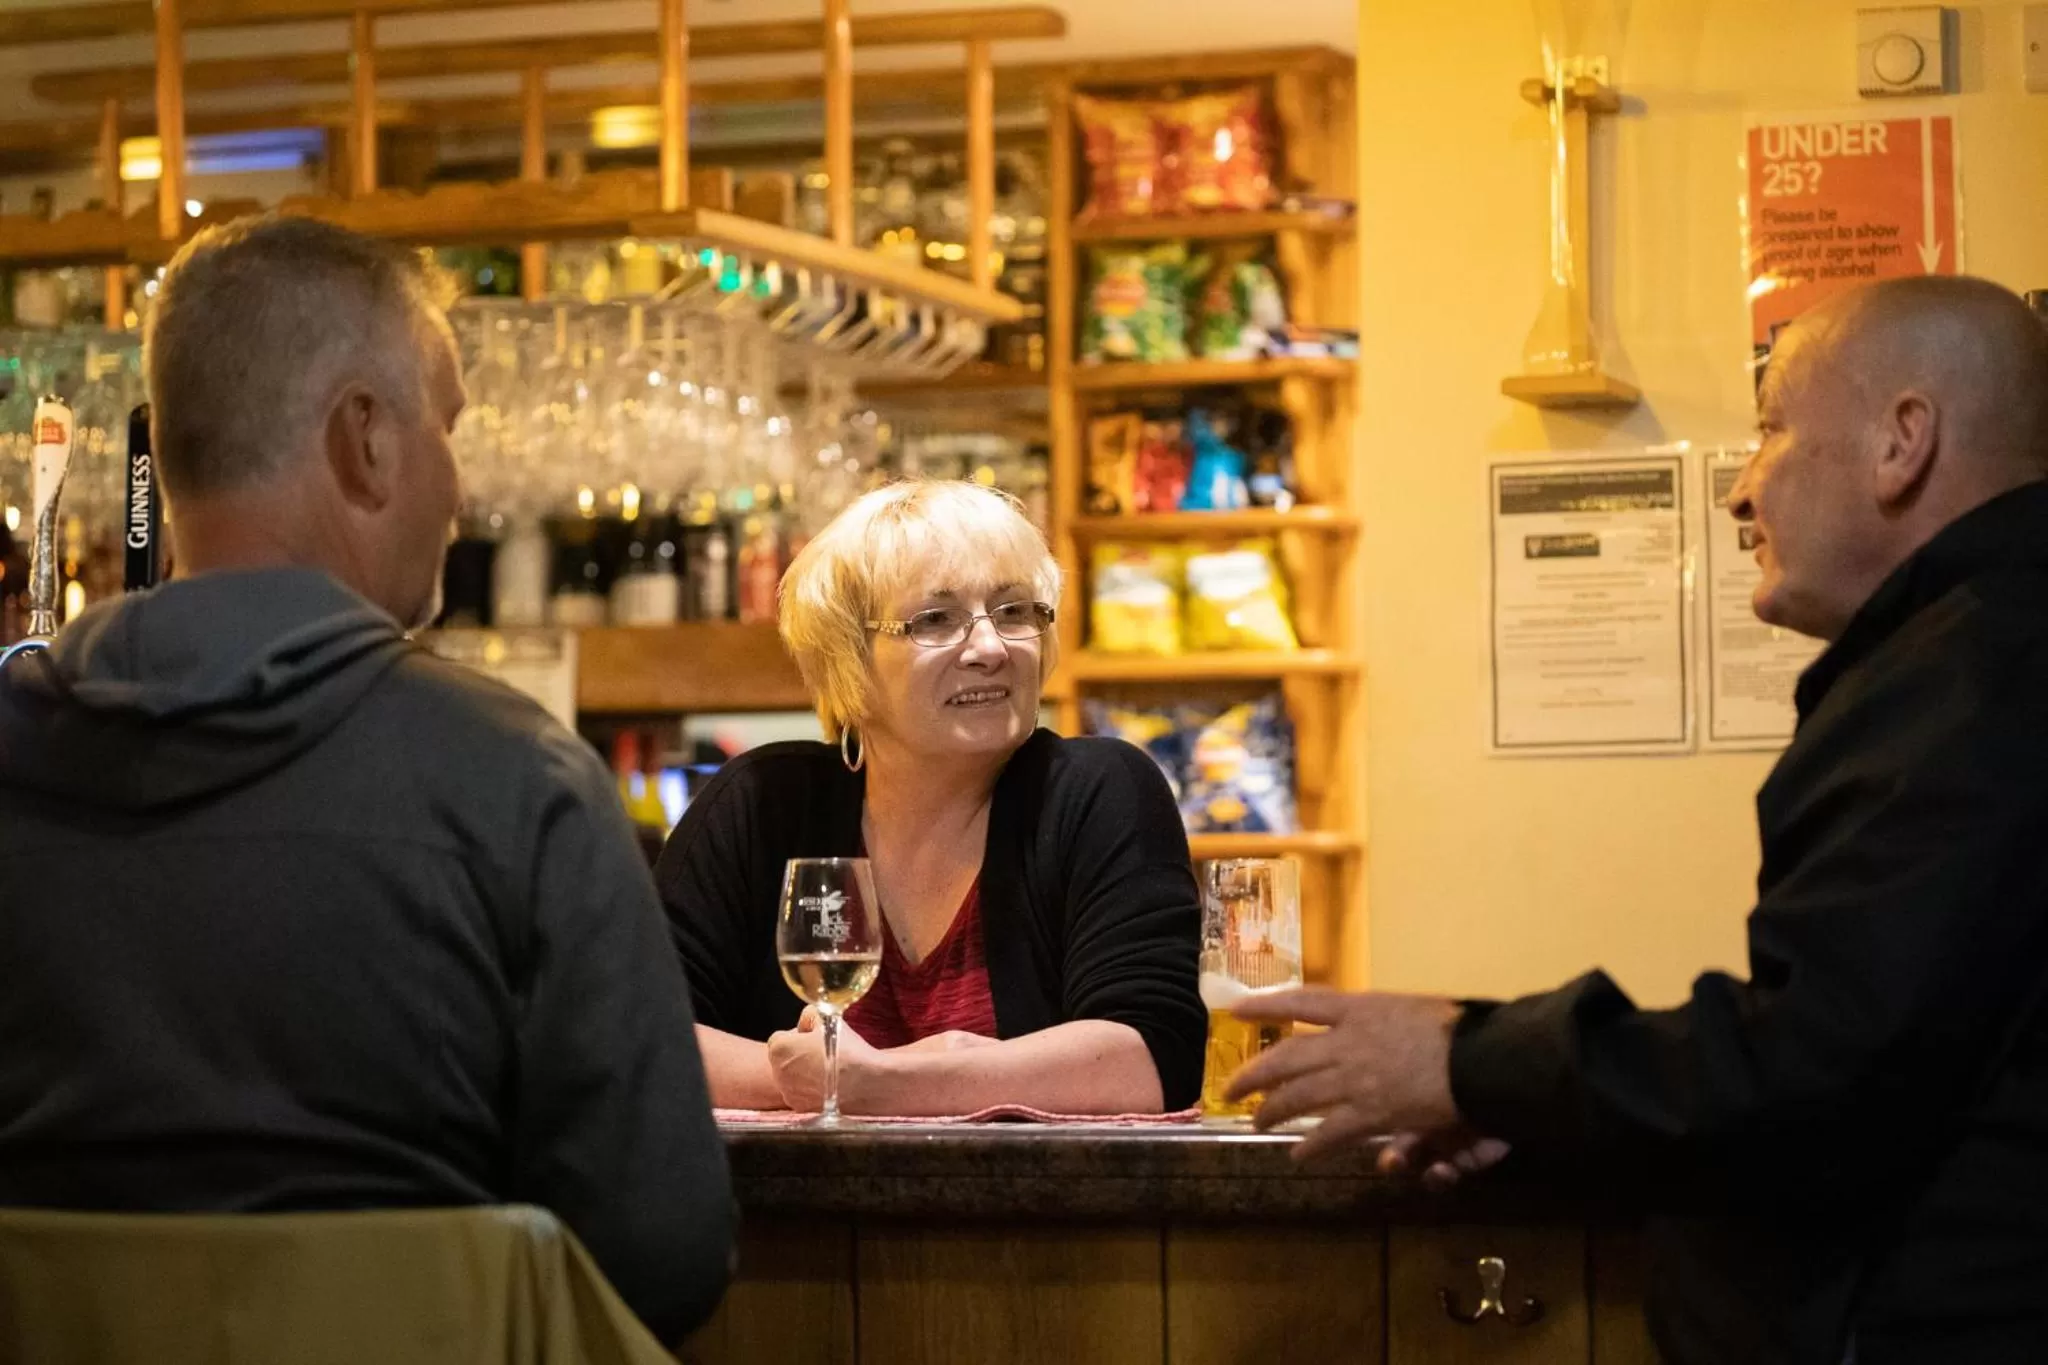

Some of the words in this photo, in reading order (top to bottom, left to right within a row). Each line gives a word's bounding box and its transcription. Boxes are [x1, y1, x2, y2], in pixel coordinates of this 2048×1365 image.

[1762, 122, 1888, 159] UNDER
[1762, 161, 1822, 197] 25?
[1761, 207, 1815, 224] Please
[1818, 207, 1837, 221] be
[1762, 226, 1834, 246] prepared
[1837, 225, 1853, 239] to
[1855, 223, 1900, 239] show
[1763, 247, 1804, 264] proof
[1806, 246, 1822, 259] of
[1826, 247, 1854, 262] age
[1858, 242, 1903, 256] when
[1820, 261, 1876, 278] alcohol
[127, 454, 151, 549] GUINNESS
